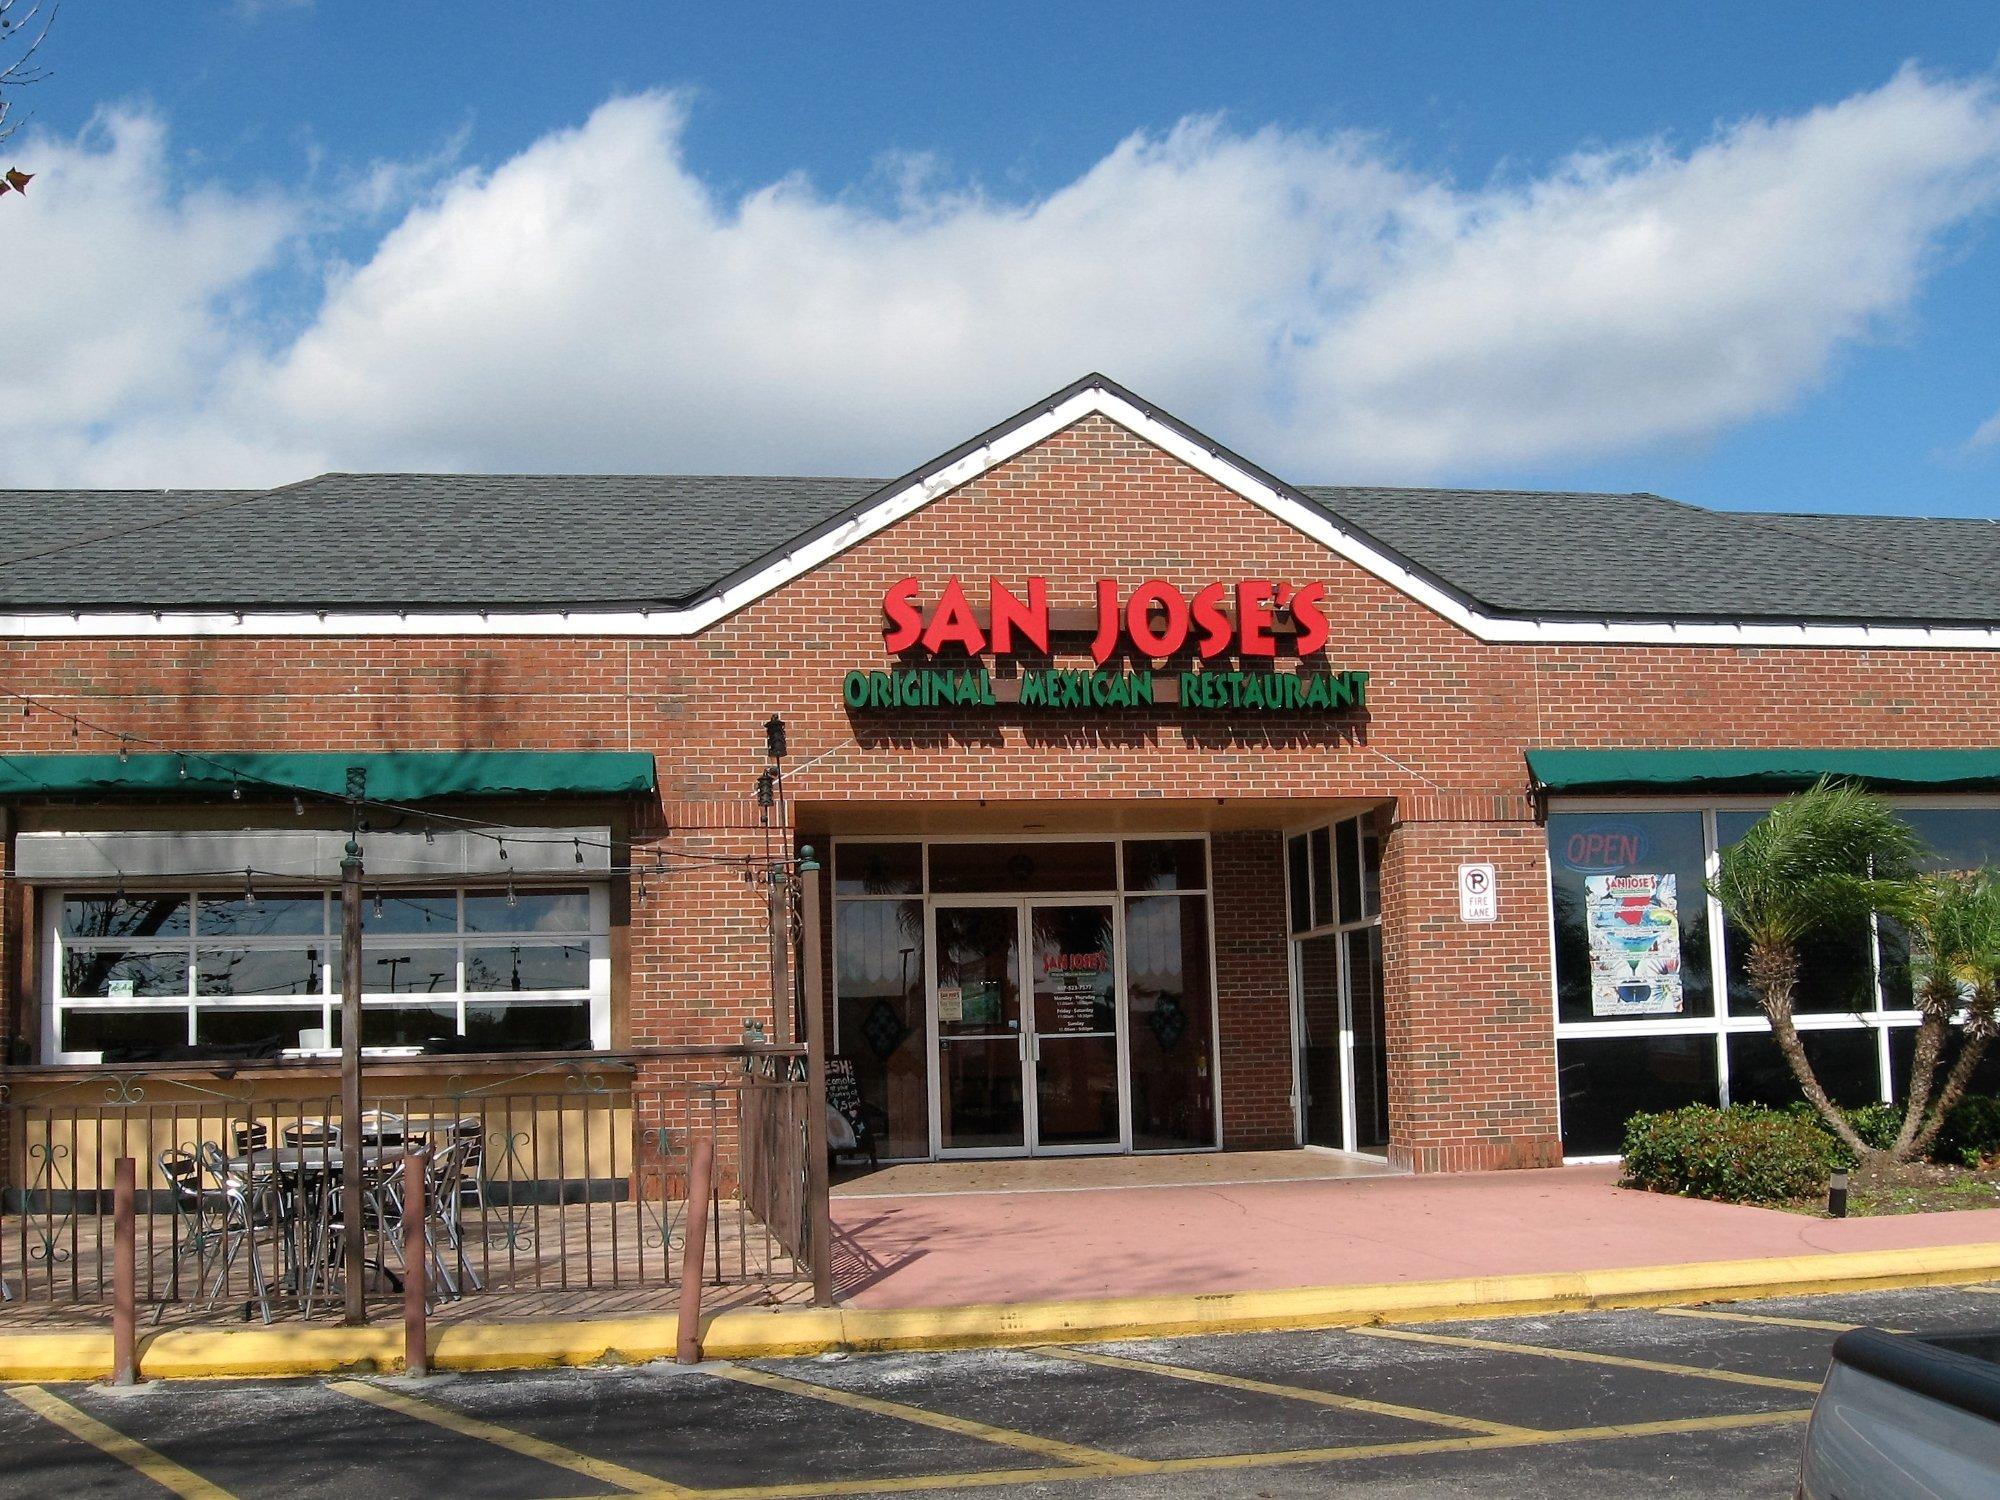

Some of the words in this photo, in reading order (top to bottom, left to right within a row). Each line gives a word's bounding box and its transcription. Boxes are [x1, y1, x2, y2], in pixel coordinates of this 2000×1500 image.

[882, 574, 1048, 656] SAN
[1090, 579, 1330, 666] JOSE'S
[843, 668, 996, 708] ORIGINAL
[1019, 667, 1153, 708] MEXICAN
[1180, 671, 1369, 709] RESTAURANT
[1567, 832, 1639, 865] OPEN
[1469, 896, 1488, 906] FIRE
[1469, 908, 1490, 918] LANE
[824, 1060, 852, 1074] ESH!
